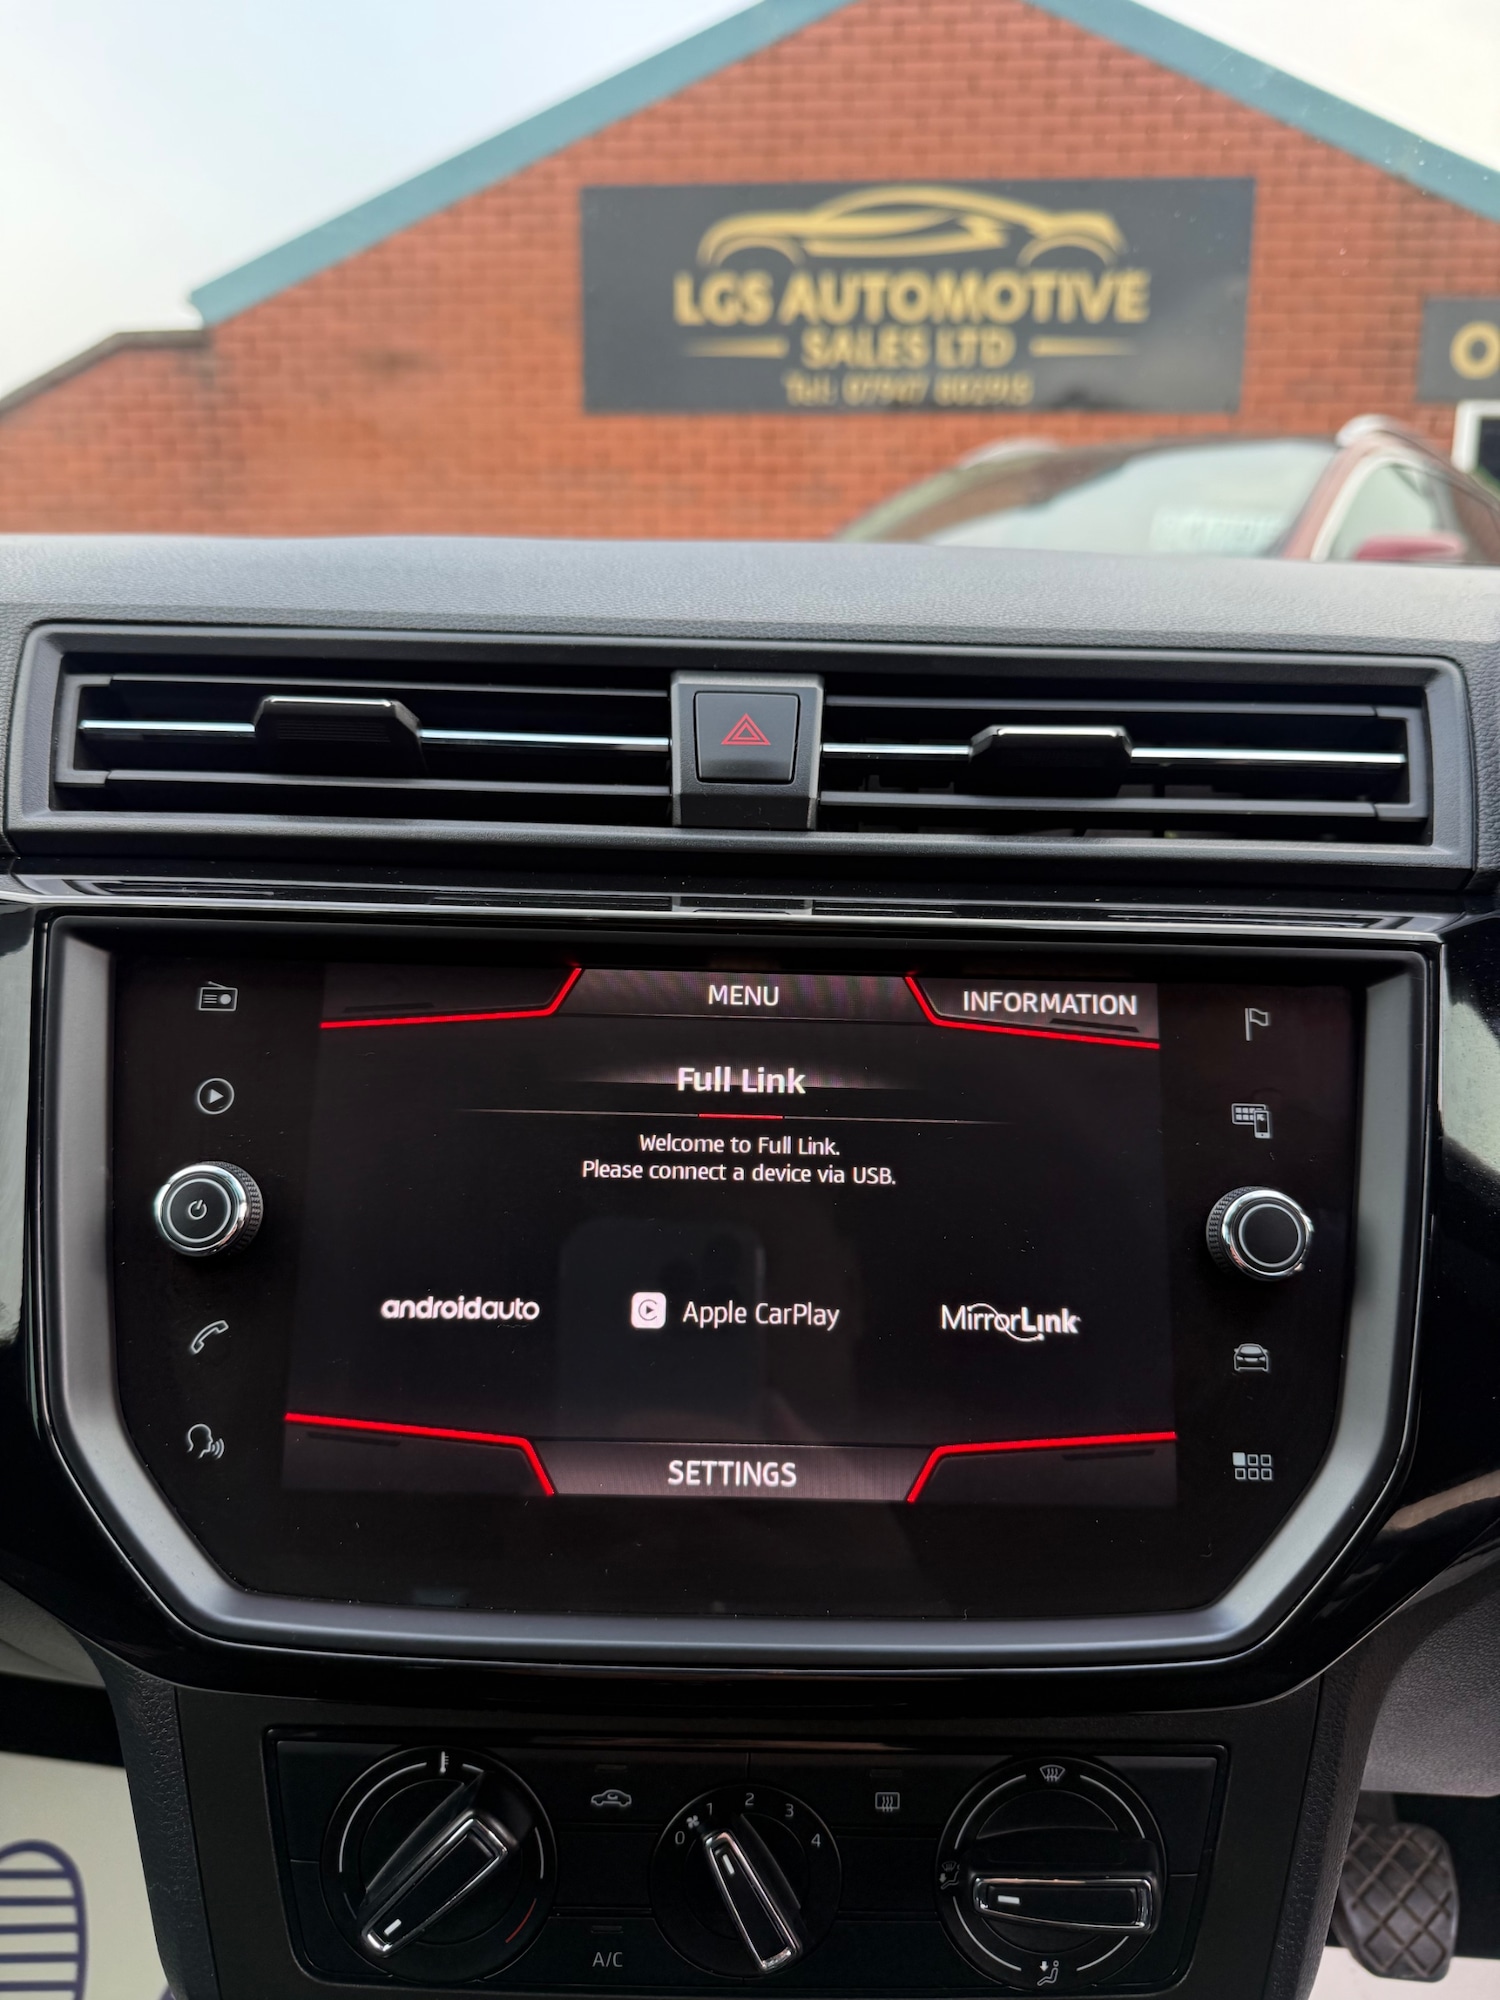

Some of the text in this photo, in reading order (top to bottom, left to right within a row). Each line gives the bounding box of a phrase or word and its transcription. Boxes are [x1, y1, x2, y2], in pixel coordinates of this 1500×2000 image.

[674, 270, 1150, 325] LGS AUTOMOTIVE
[802, 326, 1017, 369] SALES LTD
[708, 984, 779, 1006] MENU
[962, 990, 1138, 1017] INFORMATION
[676, 1066, 807, 1095] Full Link
[639, 1133, 840, 1156] Welcome to Full Link.
[582, 1159, 896, 1185] Please connect a device via USB.
[683, 1300, 840, 1331] Apple CarPlay
[941, 1303, 1081, 1342] MirrorLink
[667, 1459, 798, 1488] SETTINGS
[706, 1802, 713, 1815] 1
[745, 1792, 755, 1806] 2
[785, 1803, 794, 1818] 3
[675, 1831, 685, 1845] 0
[811, 1833, 821, 1848] 4
[592, 1951, 623, 1969] A/C
